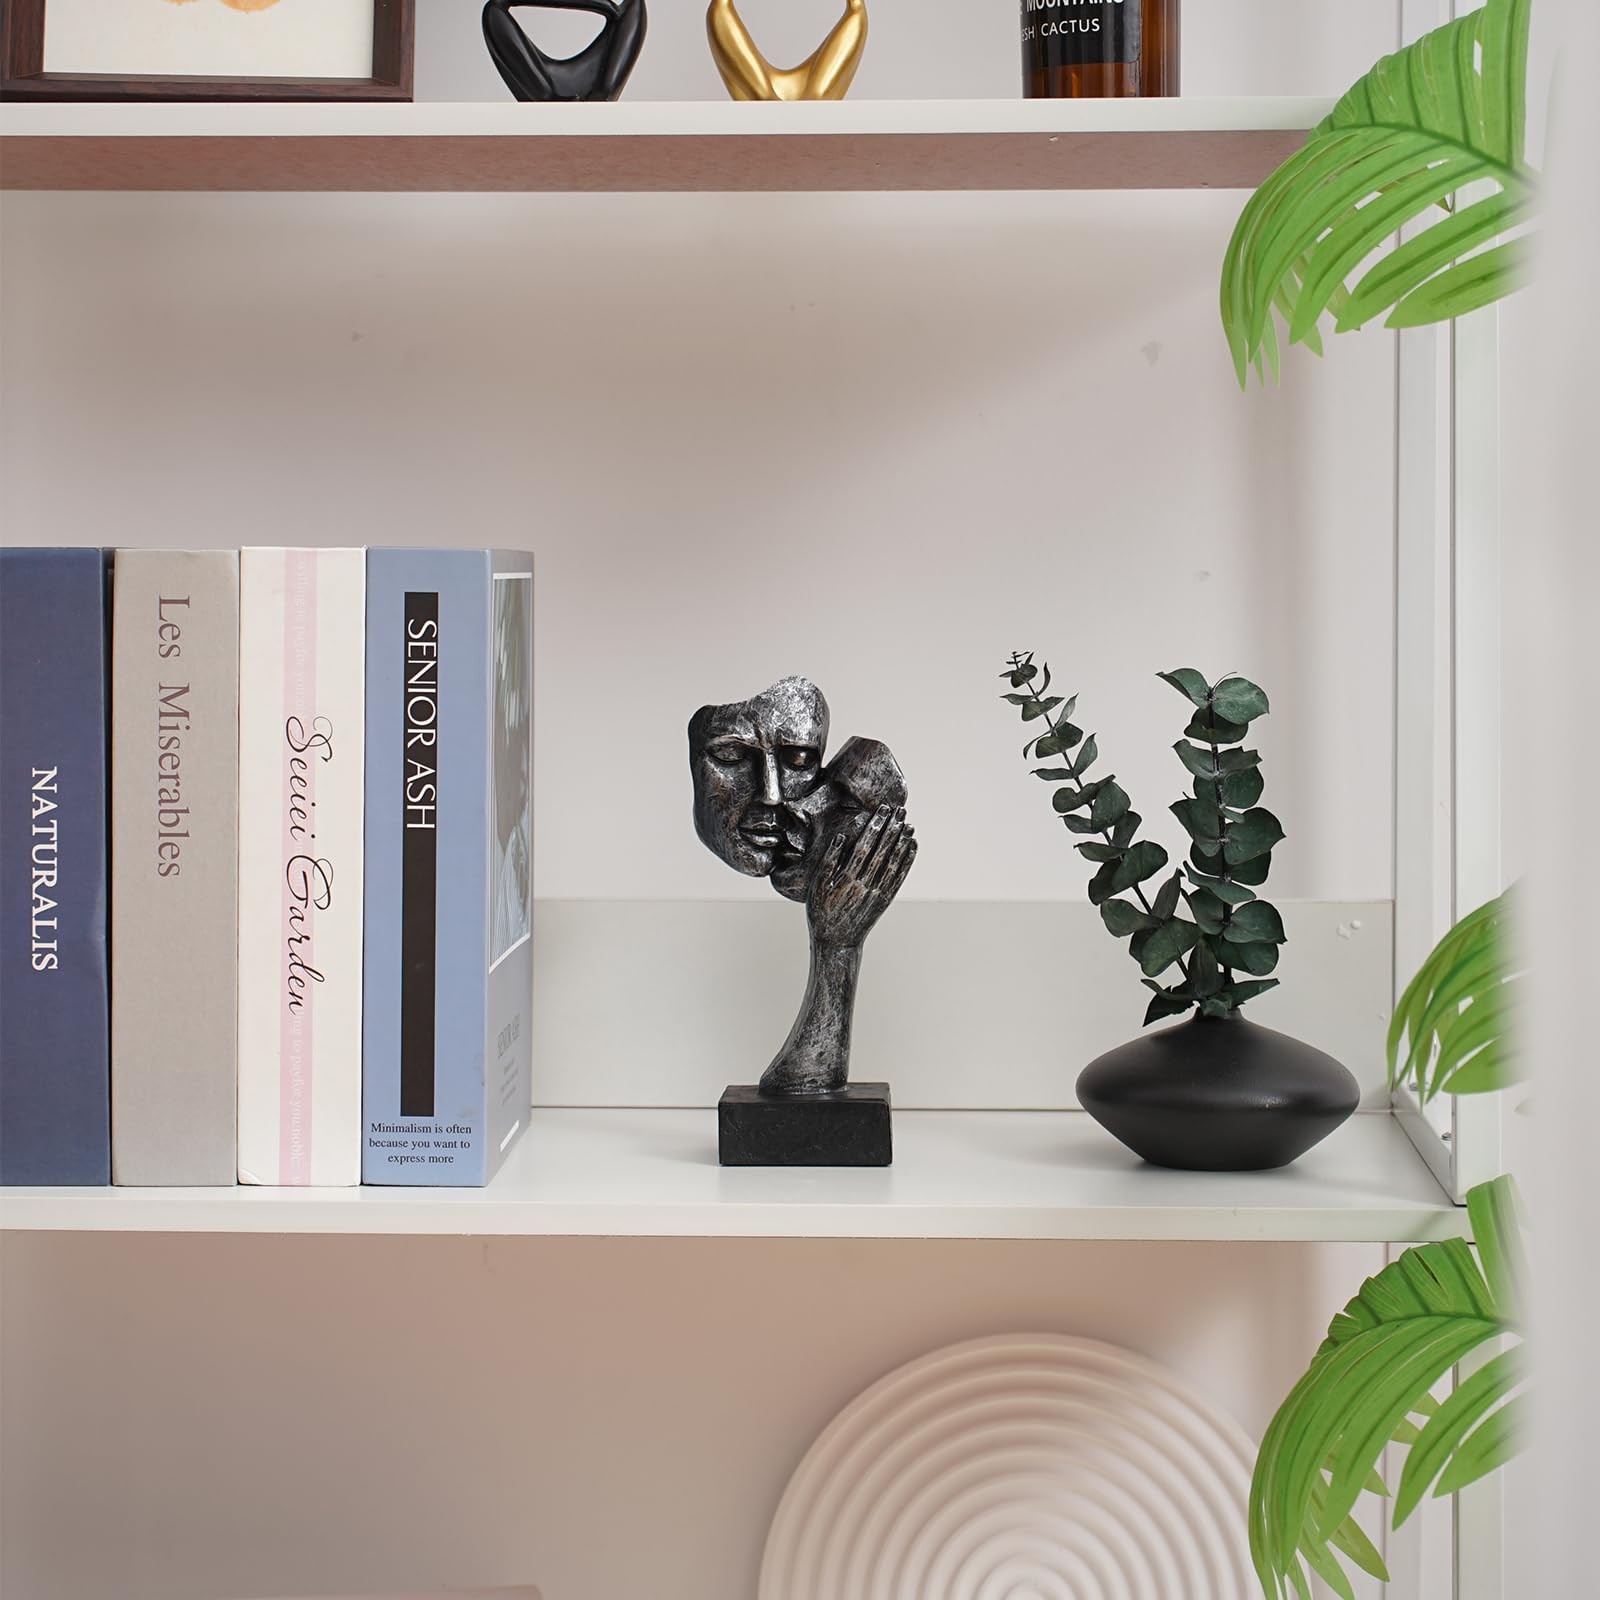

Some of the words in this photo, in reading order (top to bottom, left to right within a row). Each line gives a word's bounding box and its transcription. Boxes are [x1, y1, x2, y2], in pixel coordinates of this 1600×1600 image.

[1041, 18, 1100, 36] CACTUS
[158, 594, 190, 659] Les
[407, 618, 438, 749] SENIOR
[158, 681, 191, 878] Miserables
[406, 758, 437, 829] ASH
[31, 765, 59, 971] NATURALIS
[285, 854, 334, 1016] Garden
[369, 1138, 408, 1148] because
[411, 1140, 430, 1151] you
[433, 1140, 457, 1149] want
[460, 1140, 471, 1149] to
[371, 1123, 431, 1134] Minimalism
[434, 1123, 443, 1134] is
[446, 1123, 472, 1134] often
[387, 1154, 425, 1165] express
[428, 1155, 454, 1164] more
